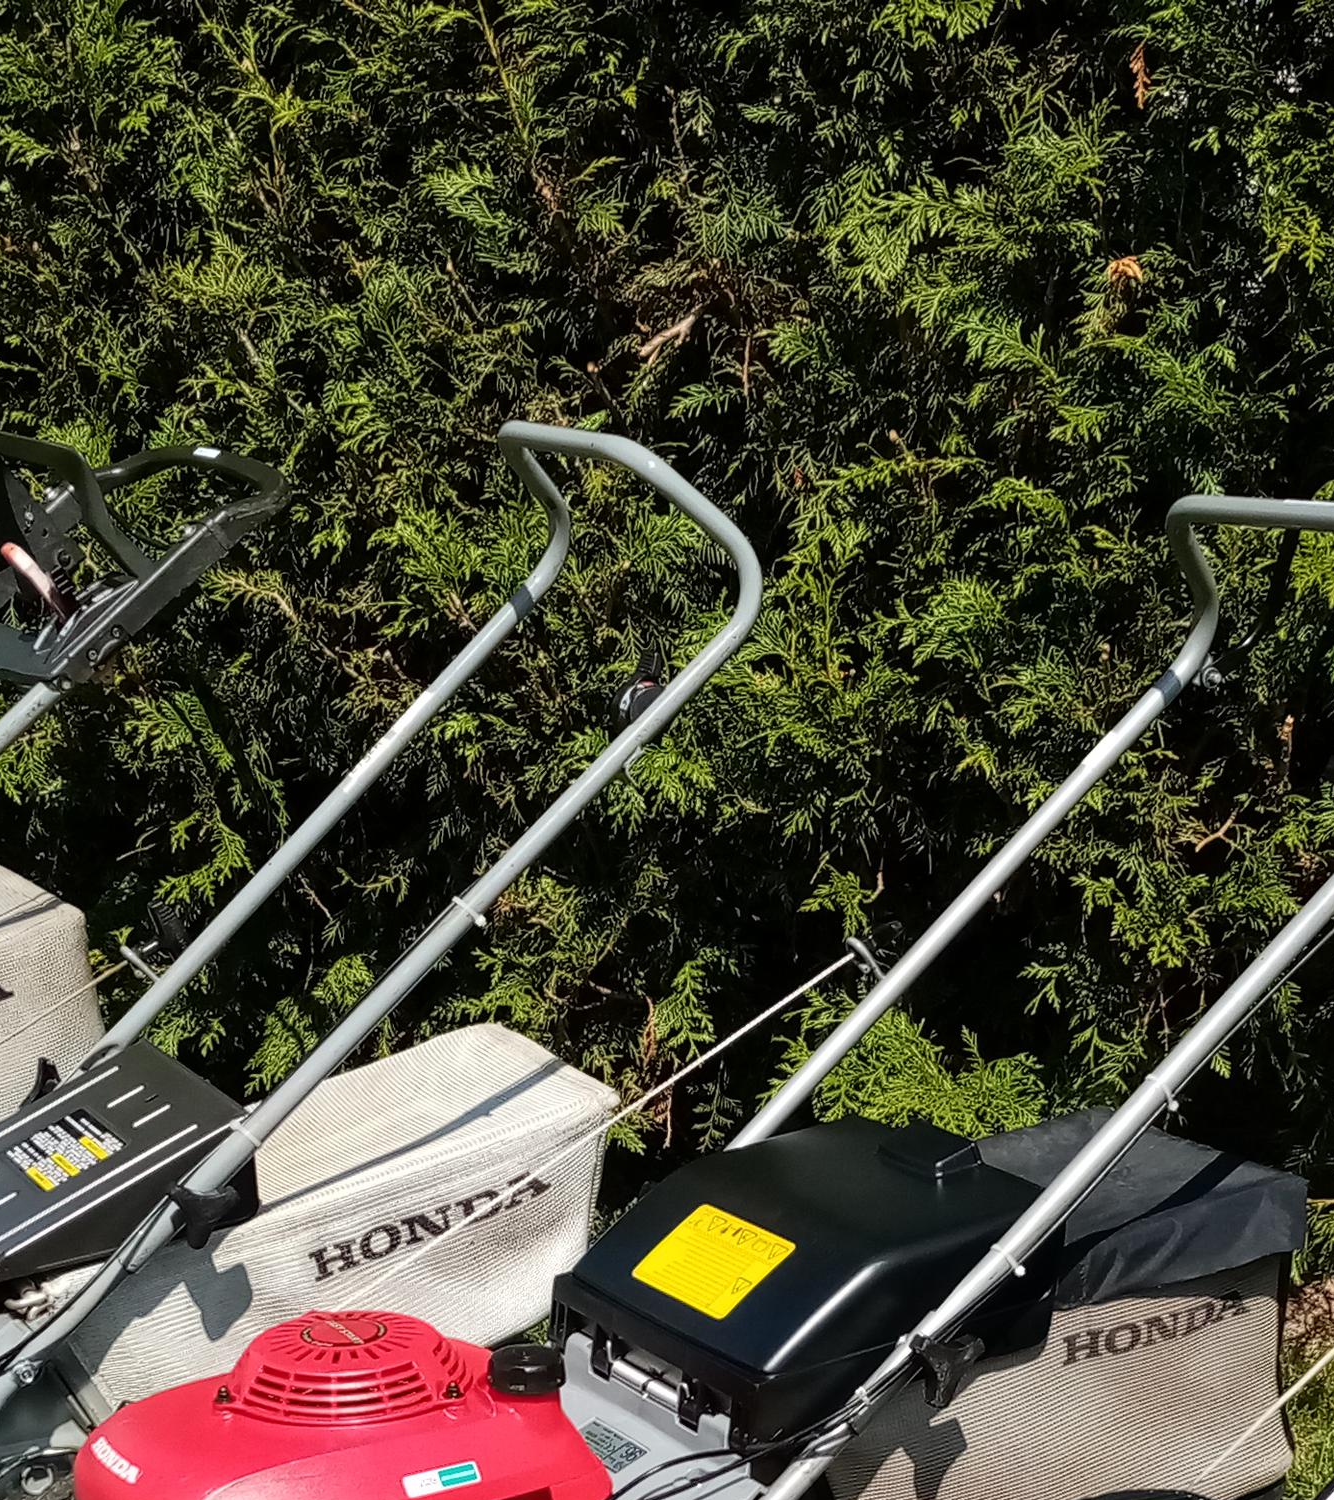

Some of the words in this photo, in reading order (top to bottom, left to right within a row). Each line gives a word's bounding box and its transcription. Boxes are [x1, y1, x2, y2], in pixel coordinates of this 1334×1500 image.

[308, 1171, 551, 1282] HONDA
[1063, 1291, 1250, 1366] HONDA
[90, 1436, 141, 1485] HONDA
